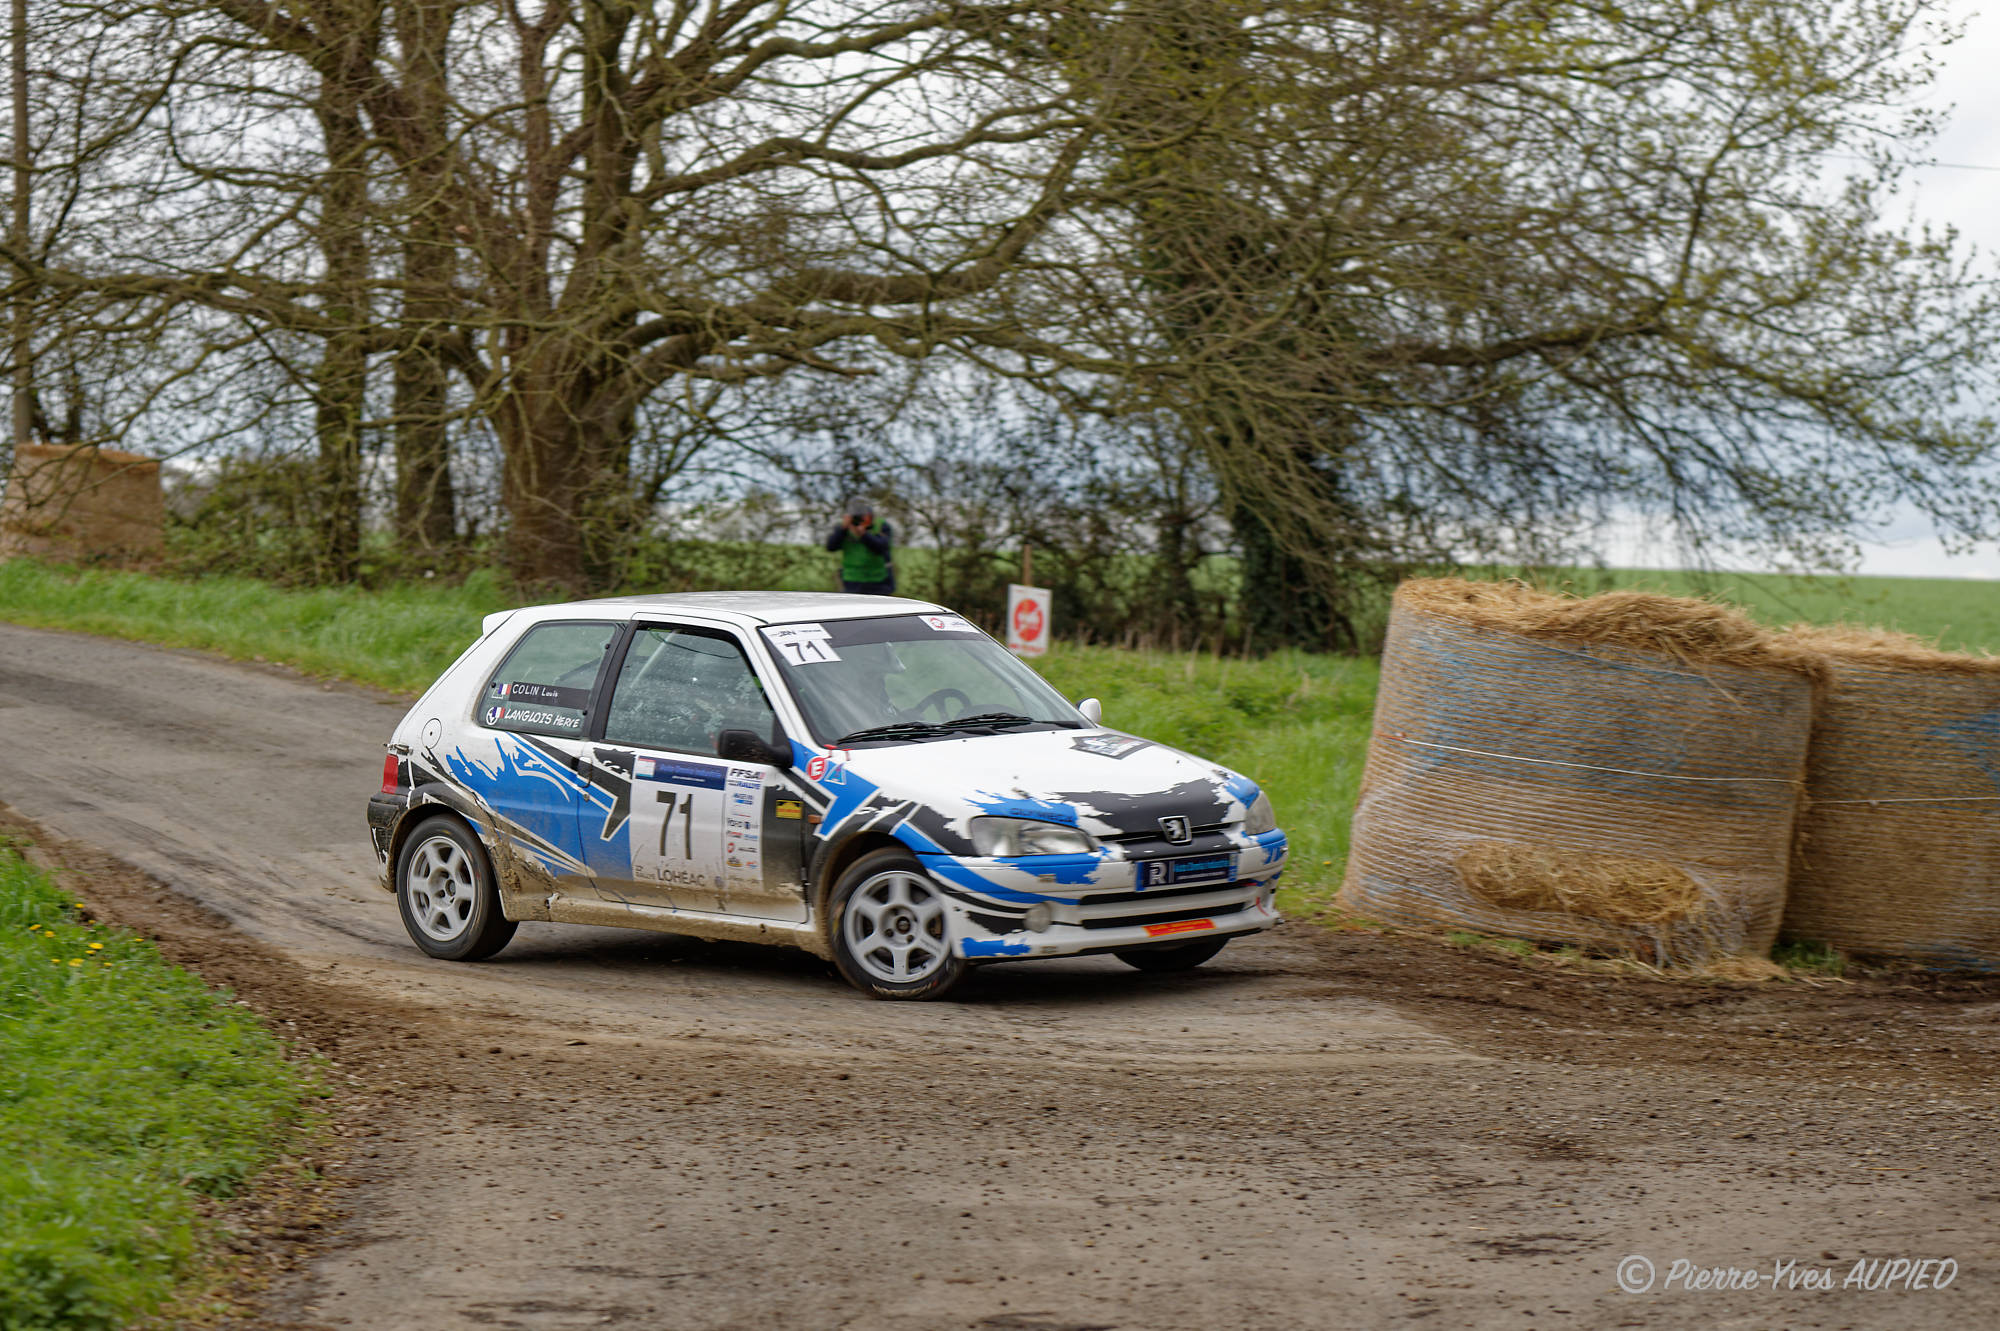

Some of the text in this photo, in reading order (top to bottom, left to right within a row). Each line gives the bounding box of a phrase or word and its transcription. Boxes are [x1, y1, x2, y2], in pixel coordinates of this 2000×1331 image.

[784, 641, 827, 662] 71
[512, 683, 540, 695] COLIN
[505, 708, 552, 725] LANGLOIS
[730, 768, 761, 780] FFSA
[656, 790, 693, 860] 71
